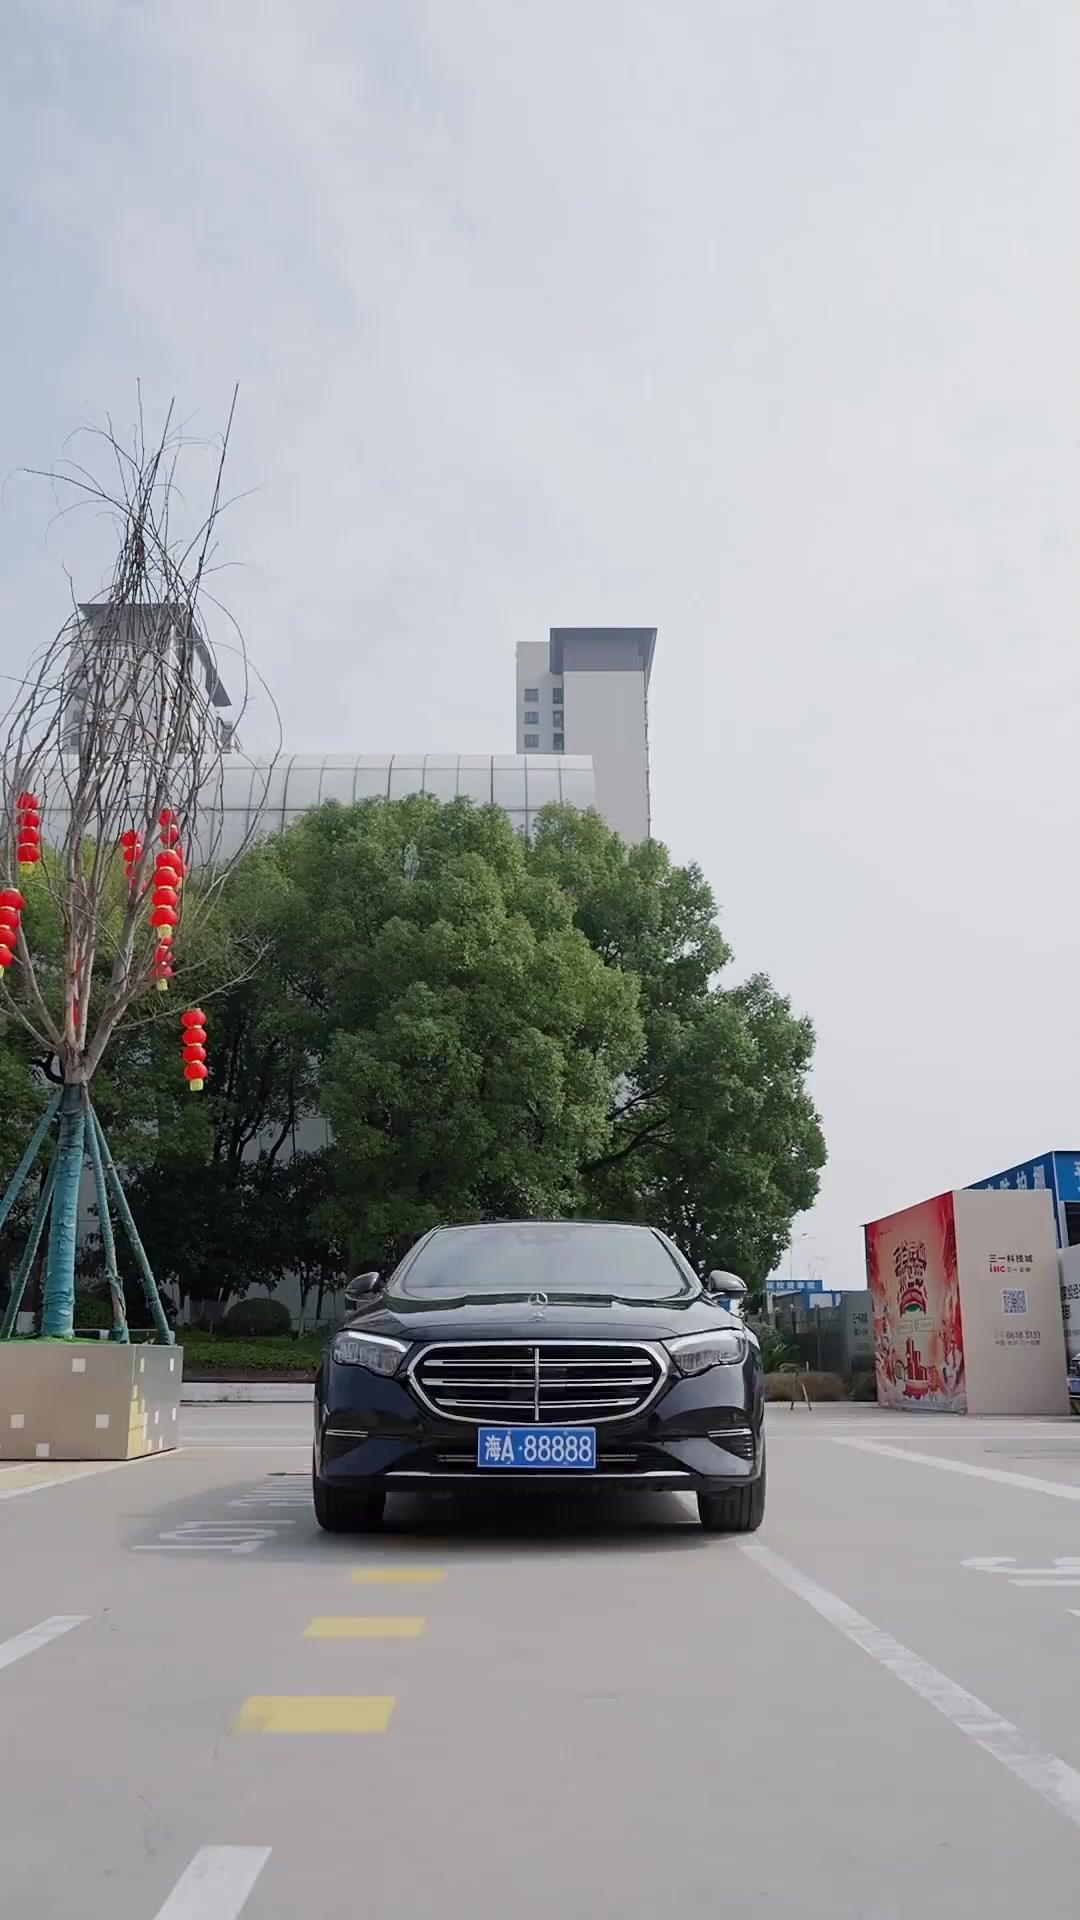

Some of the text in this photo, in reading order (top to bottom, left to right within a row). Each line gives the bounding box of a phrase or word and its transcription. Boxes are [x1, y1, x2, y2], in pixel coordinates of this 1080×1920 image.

[989, 1254, 1033, 1264] 三一科技城
